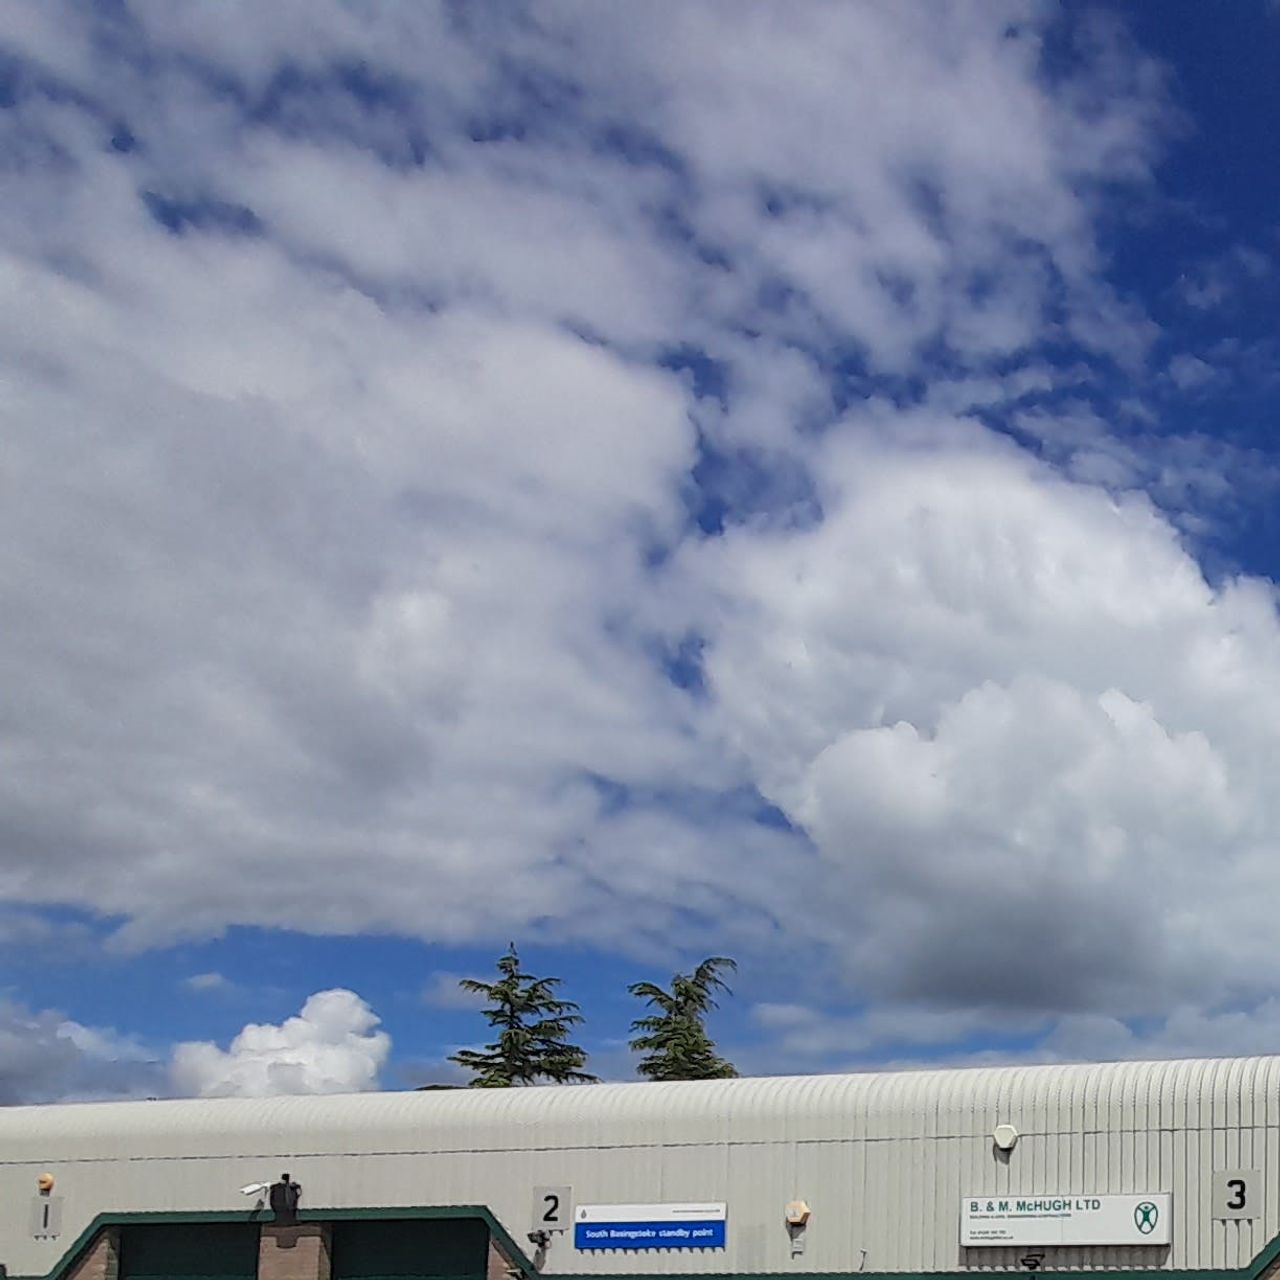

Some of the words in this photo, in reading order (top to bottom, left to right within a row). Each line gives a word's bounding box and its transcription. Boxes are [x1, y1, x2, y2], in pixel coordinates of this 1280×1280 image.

[1227, 1179, 1246, 1210] 3
[543, 1195, 559, 1221] 2
[970, 1202, 982, 1212] B.
[986, 1201, 995, 1212] &
[999, 1201, 1012, 1212] M.
[1016, 1200, 1072, 1211] McHUGH
[1075, 1199, 1101, 1210] LTD
[586, 1229, 609, 1238] South
[658, 1229, 690, 1239] standby
[692, 1228, 714, 1238] point
